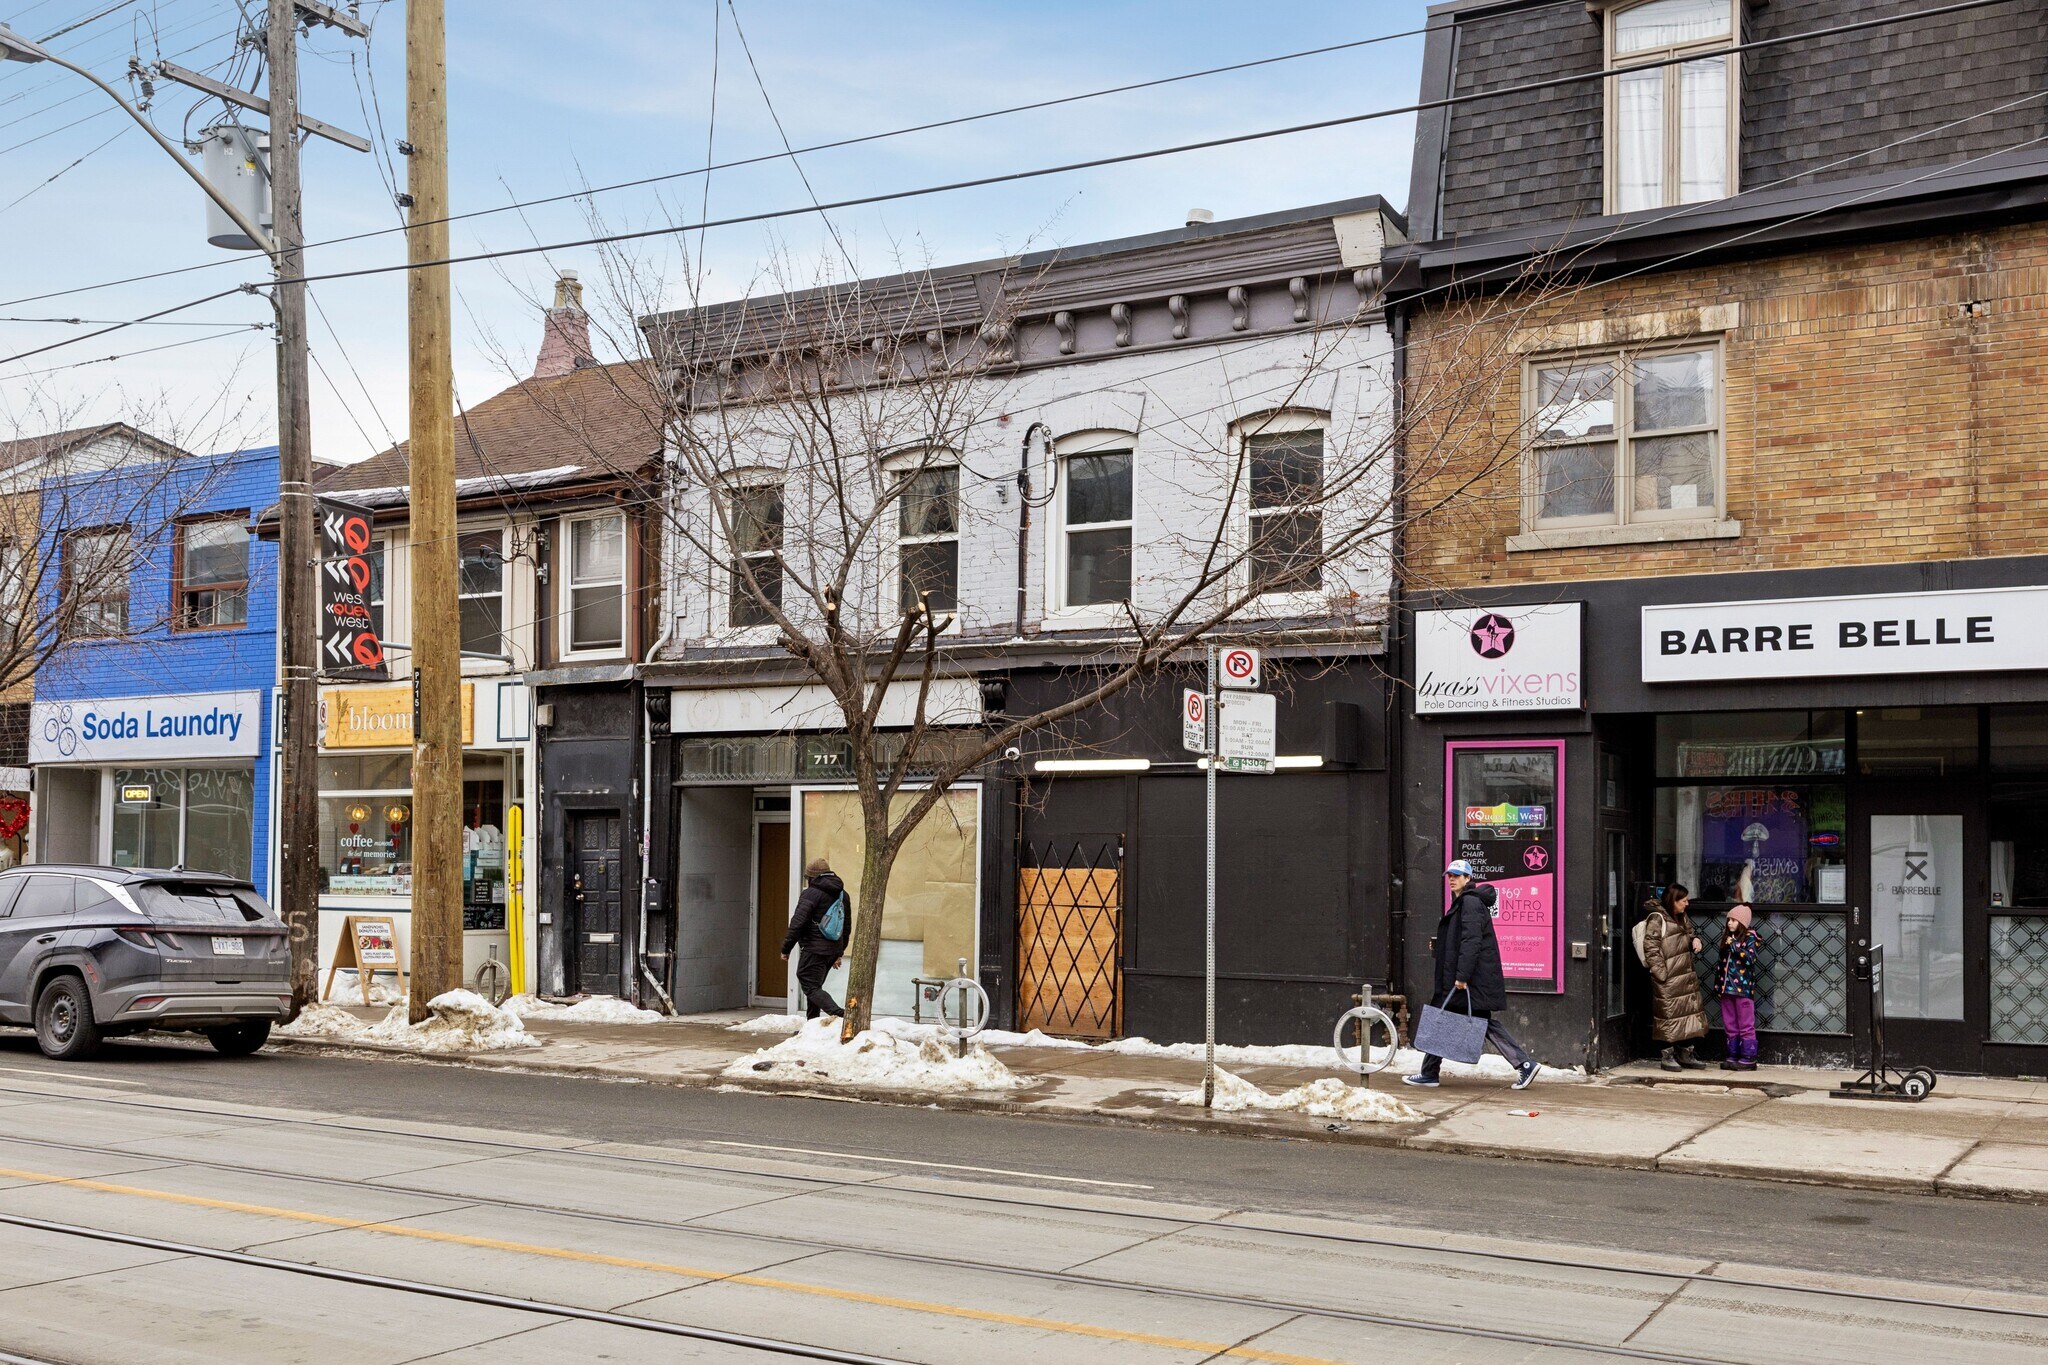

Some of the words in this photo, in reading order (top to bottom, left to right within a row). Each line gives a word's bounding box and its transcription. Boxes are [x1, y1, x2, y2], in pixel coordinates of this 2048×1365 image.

[224, 148, 234, 156] H2
[246, 168, 255, 176] TC
[334, 591, 363, 605] wes
[334, 616, 369, 629] west
[1660, 624, 1814, 656] BARRE
[1838, 616, 1995, 649] BELLE
[1418, 671, 1480, 698] brass
[1482, 668, 1577, 694] vixens
[1424, 700, 1445, 709] Pole
[1447, 698, 1489, 710] Dancing
[1492, 699, 1498, 707] &
[1502, 697, 1534, 706] Fitness
[1536, 696, 1571, 706] Studios
[82, 711, 139, 741] Soda
[146, 707, 242, 742] Laundry
[1184, 730, 1198, 741] EXCEPT
[1188, 740, 1200, 750] PERMIT
[814, 754, 838, 764] 717
[1242, 758, 1266, 766] 4304
[125, 789, 148, 798] OPEN
[1506, 812, 1518, 820] St.
[1520, 812, 1542, 820] West
[340, 834, 373, 847] coffee
[364, 850, 396, 858] memories
[1892, 886, 1942, 896] BARREBELLE
[1502, 900, 1542, 911] INTRO
[1502, 910, 1545, 922] OFFER
